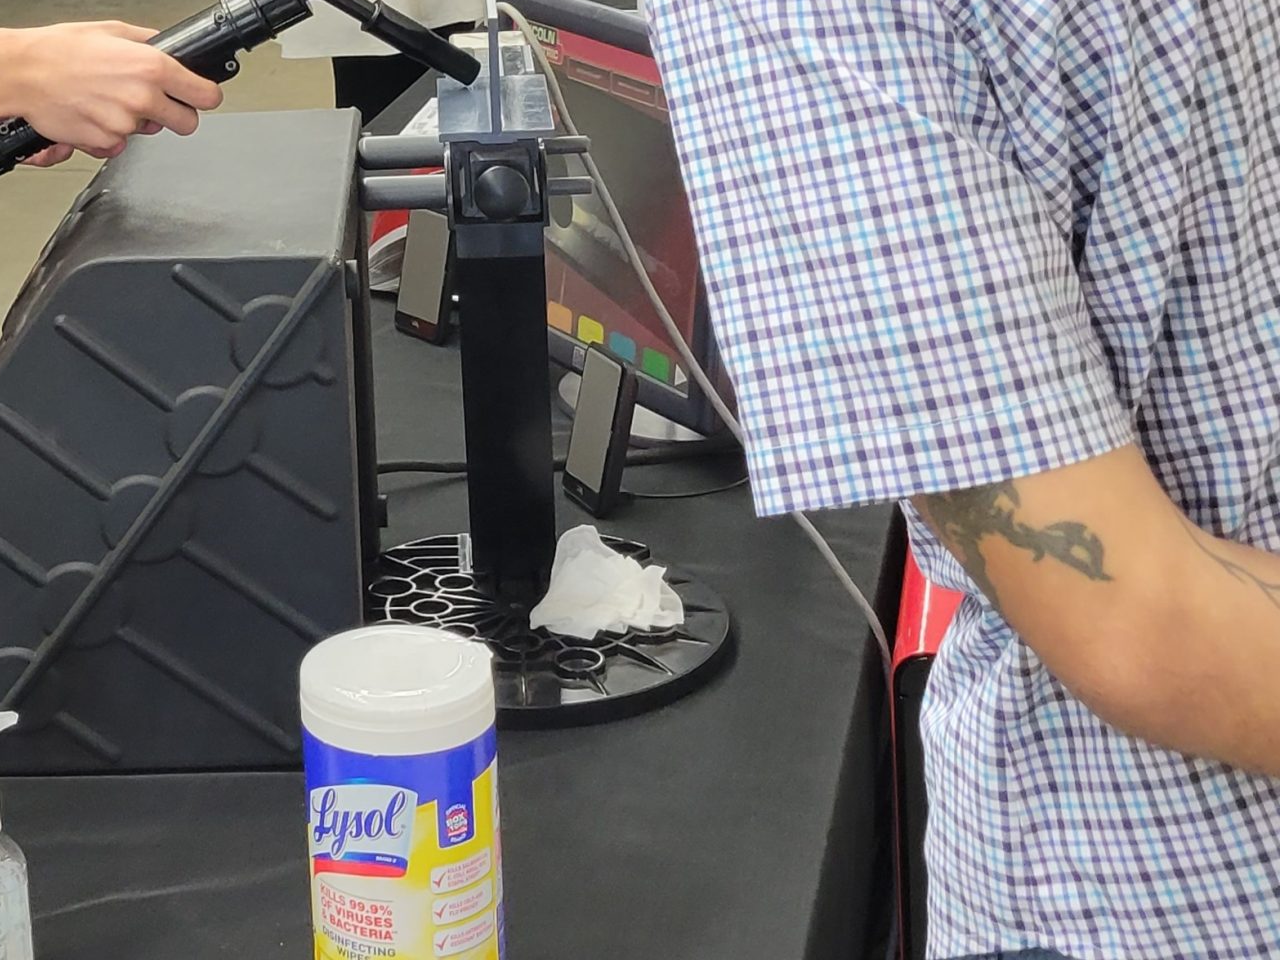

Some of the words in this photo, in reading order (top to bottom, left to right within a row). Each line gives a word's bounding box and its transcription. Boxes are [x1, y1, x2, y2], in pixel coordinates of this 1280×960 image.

[531, 23, 556, 46] COLN
[312, 788, 406, 856] Lysol
[320, 882, 346, 907] KILLS
[349, 899, 393, 917] 99.9%
[321, 895, 333, 910] OF
[335, 905, 393, 929] VIRUSES
[322, 924, 396, 958] DISINFECTING
[329, 913, 394, 941] BACTERIA
